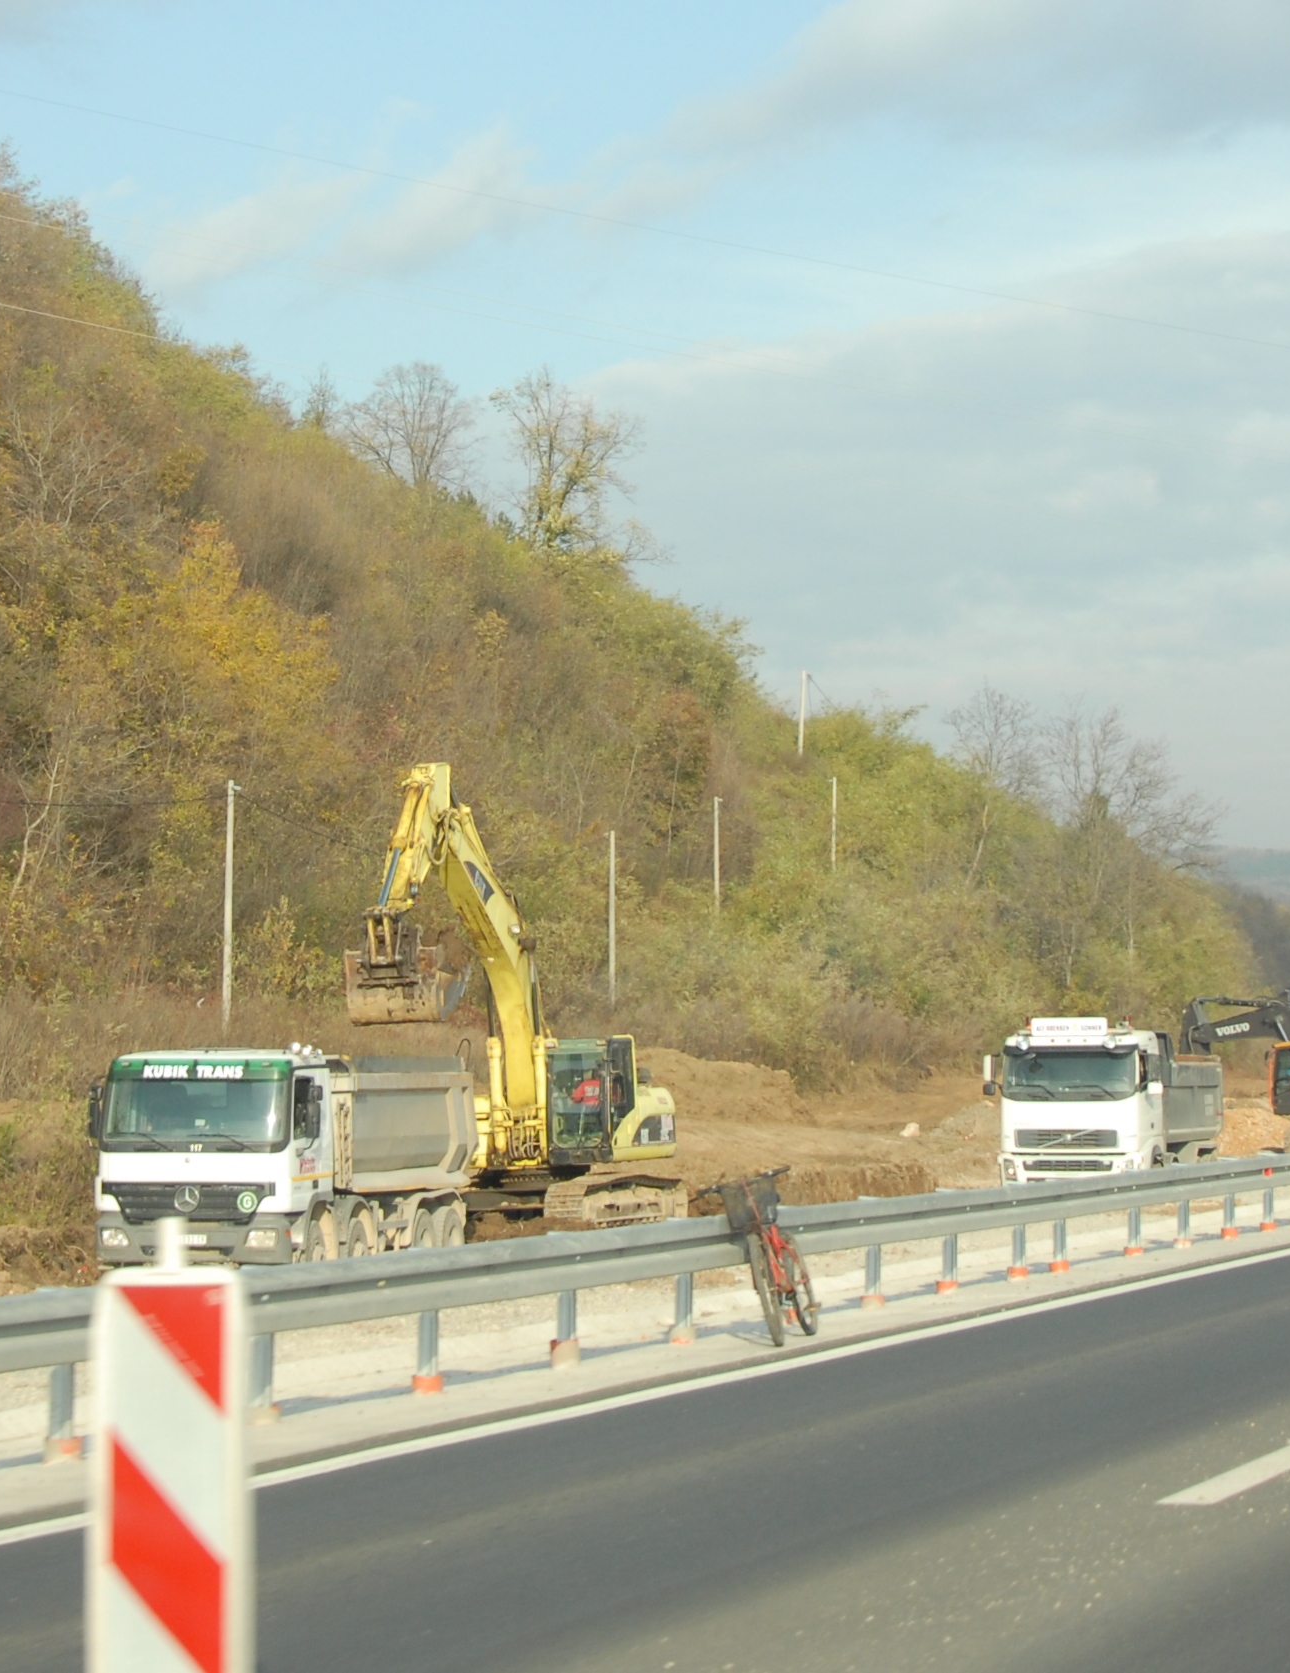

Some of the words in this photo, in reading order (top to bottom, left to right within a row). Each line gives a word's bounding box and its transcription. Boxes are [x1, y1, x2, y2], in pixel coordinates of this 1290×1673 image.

[1215, 1022, 1250, 1037] VOLVO
[143, 1065, 189, 1079] KUBIK
[196, 1065, 244, 1079] TRANS
[190, 1143, 203, 1152] 117
